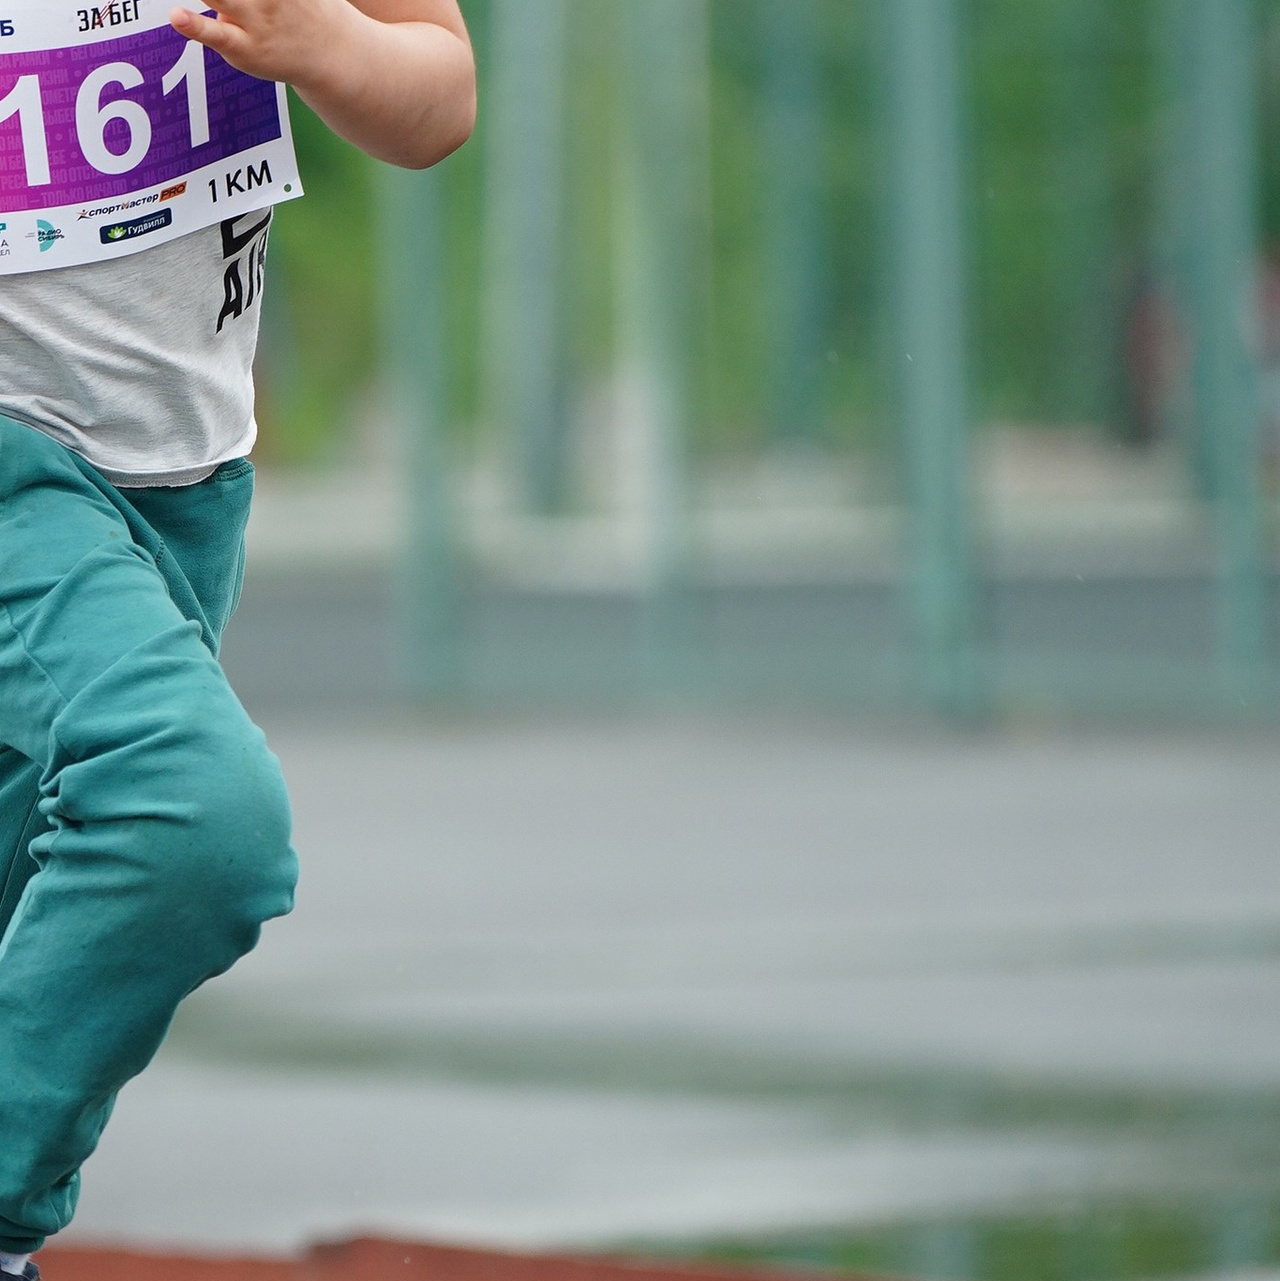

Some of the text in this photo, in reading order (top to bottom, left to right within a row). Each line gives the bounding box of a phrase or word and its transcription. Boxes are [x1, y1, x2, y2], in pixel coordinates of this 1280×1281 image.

[208, 160, 273, 203] 1 КМ
[161, 184, 186, 200] PRO
[127, 216, 165, 235] Гудвилл
